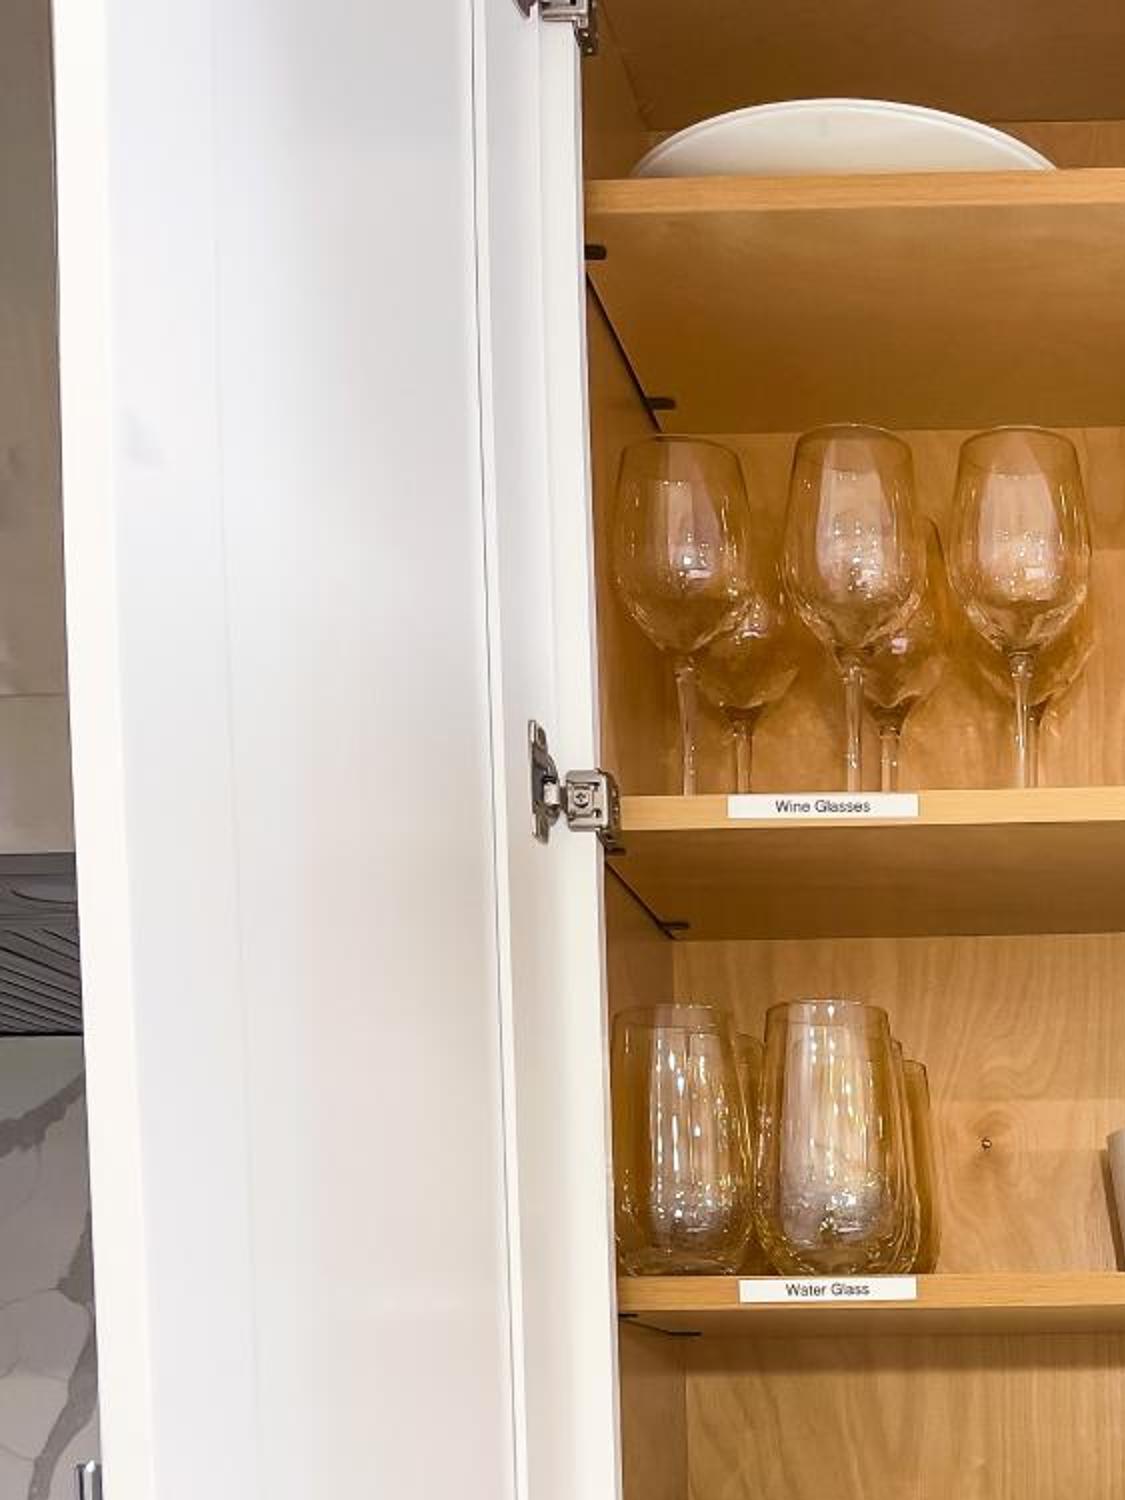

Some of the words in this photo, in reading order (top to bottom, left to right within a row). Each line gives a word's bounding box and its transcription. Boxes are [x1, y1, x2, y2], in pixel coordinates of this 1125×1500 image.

[775, 799, 811, 813] Wine
[815, 799, 871, 813] Glasses
[785, 1283, 827, 1297] Water
[831, 1282, 871, 1296] Glass
